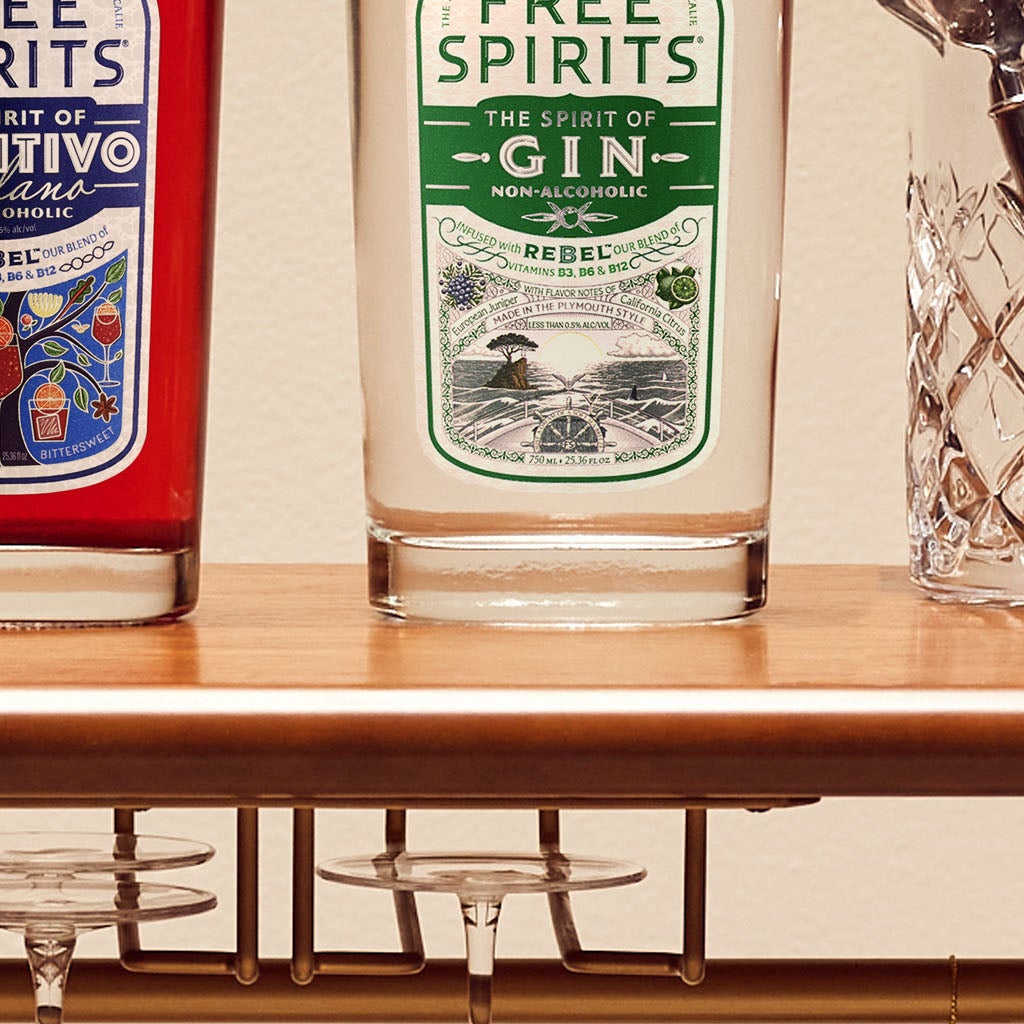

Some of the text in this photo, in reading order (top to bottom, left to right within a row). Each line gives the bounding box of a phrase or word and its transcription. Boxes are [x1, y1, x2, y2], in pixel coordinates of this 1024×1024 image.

[441, 4, 450, 28] THE
[54, 109, 86, 126] OF
[484, 110, 656, 127] THE SPIRIT OF
[498, 134, 647, 178] GIN
[491, 185, 648, 198] NON-ALCOHOLIC
[42, 245, 65, 260] OUR
[66, 232, 97, 254] BLEND
[98, 224, 109, 239] of
[456, 221, 497, 247] INFUSED
[499, 240, 522, 255] with
[613, 240, 636, 255] OUR
[637, 228, 669, 249] BLEND
[670, 221, 681, 235] of
[7, 271, 23, 282] B6
[25, 269, 34, 280] &
[36, 265, 57, 278] B12
[508, 260, 629, 278] VITAMINS B3, B6 & B12
[524, 285, 617, 297] WITH FLAVOR NOTES OF
[451, 295, 518, 337] European Juniper
[493, 301, 647, 326] MADE IN THE PLYMOUTH STYLE
[620, 293, 686, 337] California Citrus
[528, 321, 546, 329] LESS
[547, 320, 564, 329] THAN
[40, 426, 116, 461] BITTERSWEET
[529, 455, 611, 465] 750 ML 25.36 FL OZ
